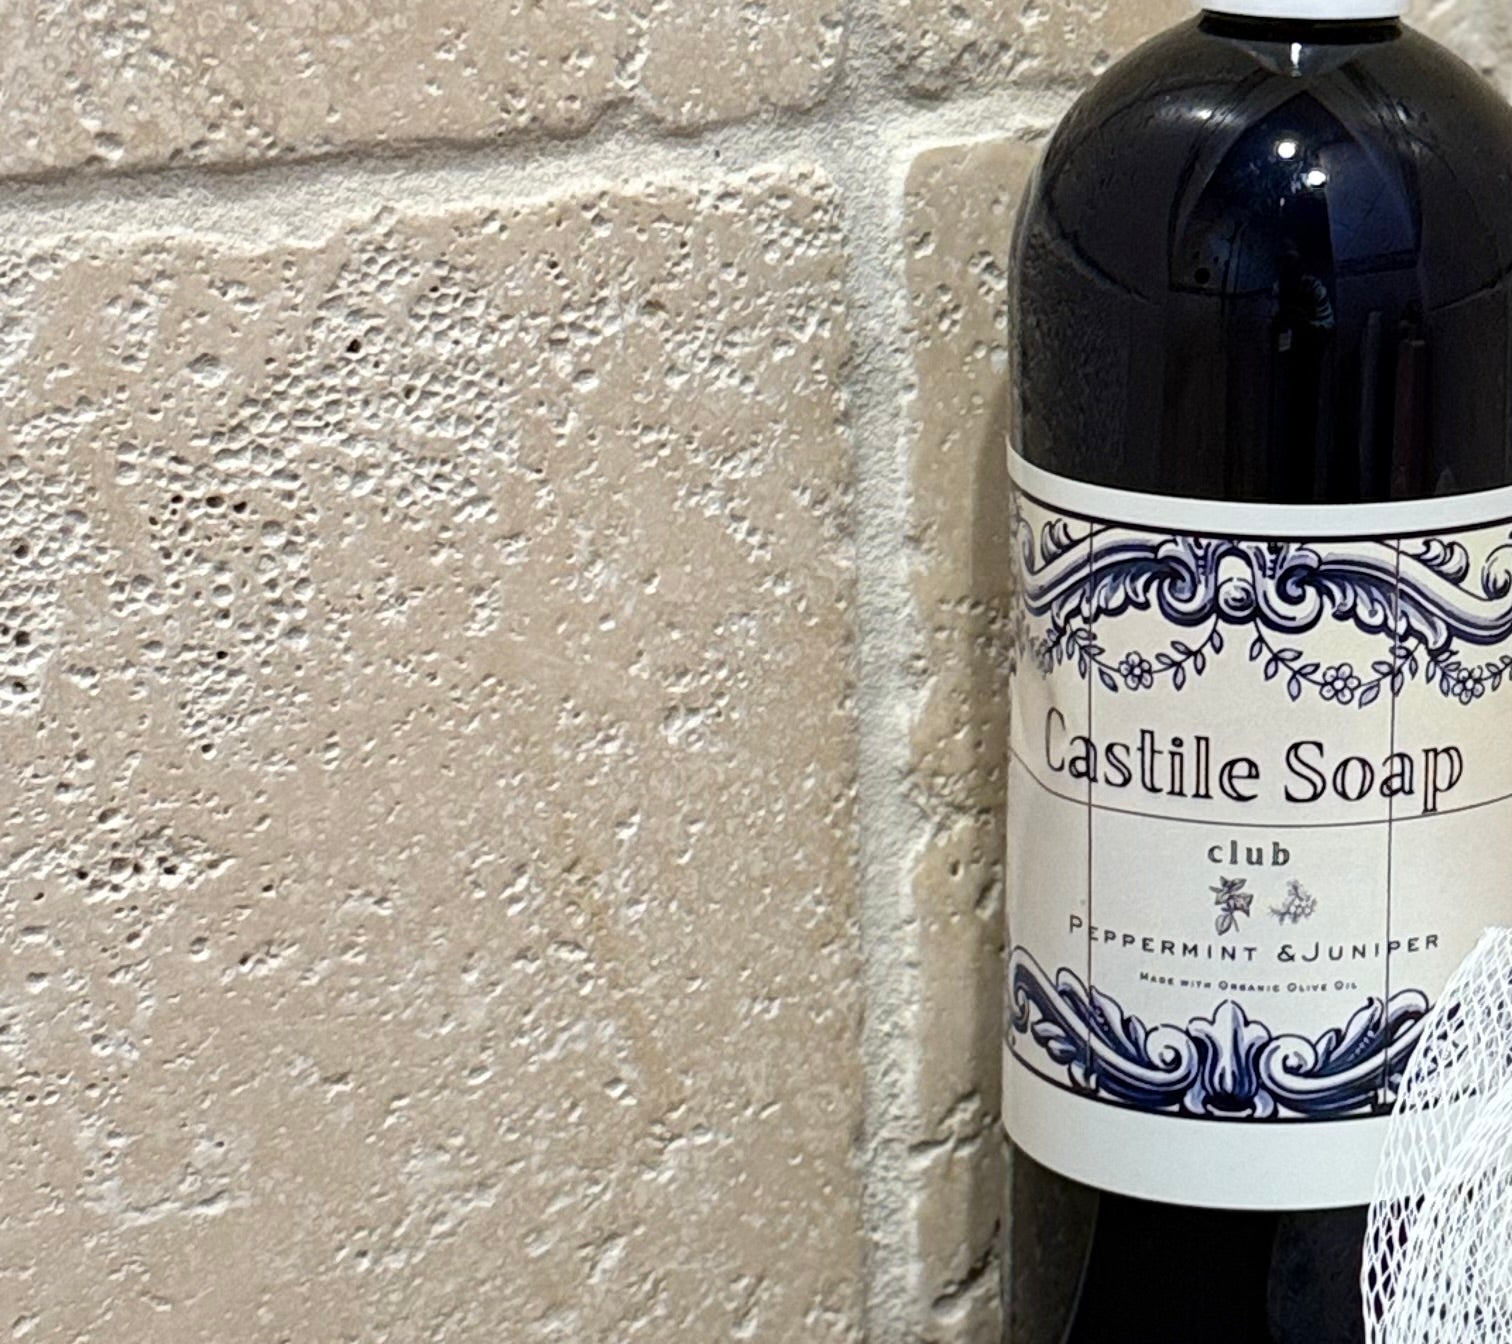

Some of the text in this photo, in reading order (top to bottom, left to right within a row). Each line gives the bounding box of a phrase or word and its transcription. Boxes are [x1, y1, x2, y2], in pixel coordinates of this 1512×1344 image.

[1045, 706, 1463, 814] Castile Soap
[1207, 840, 1290, 866] club
[1069, 914, 1257, 961] PEPPERMINT
